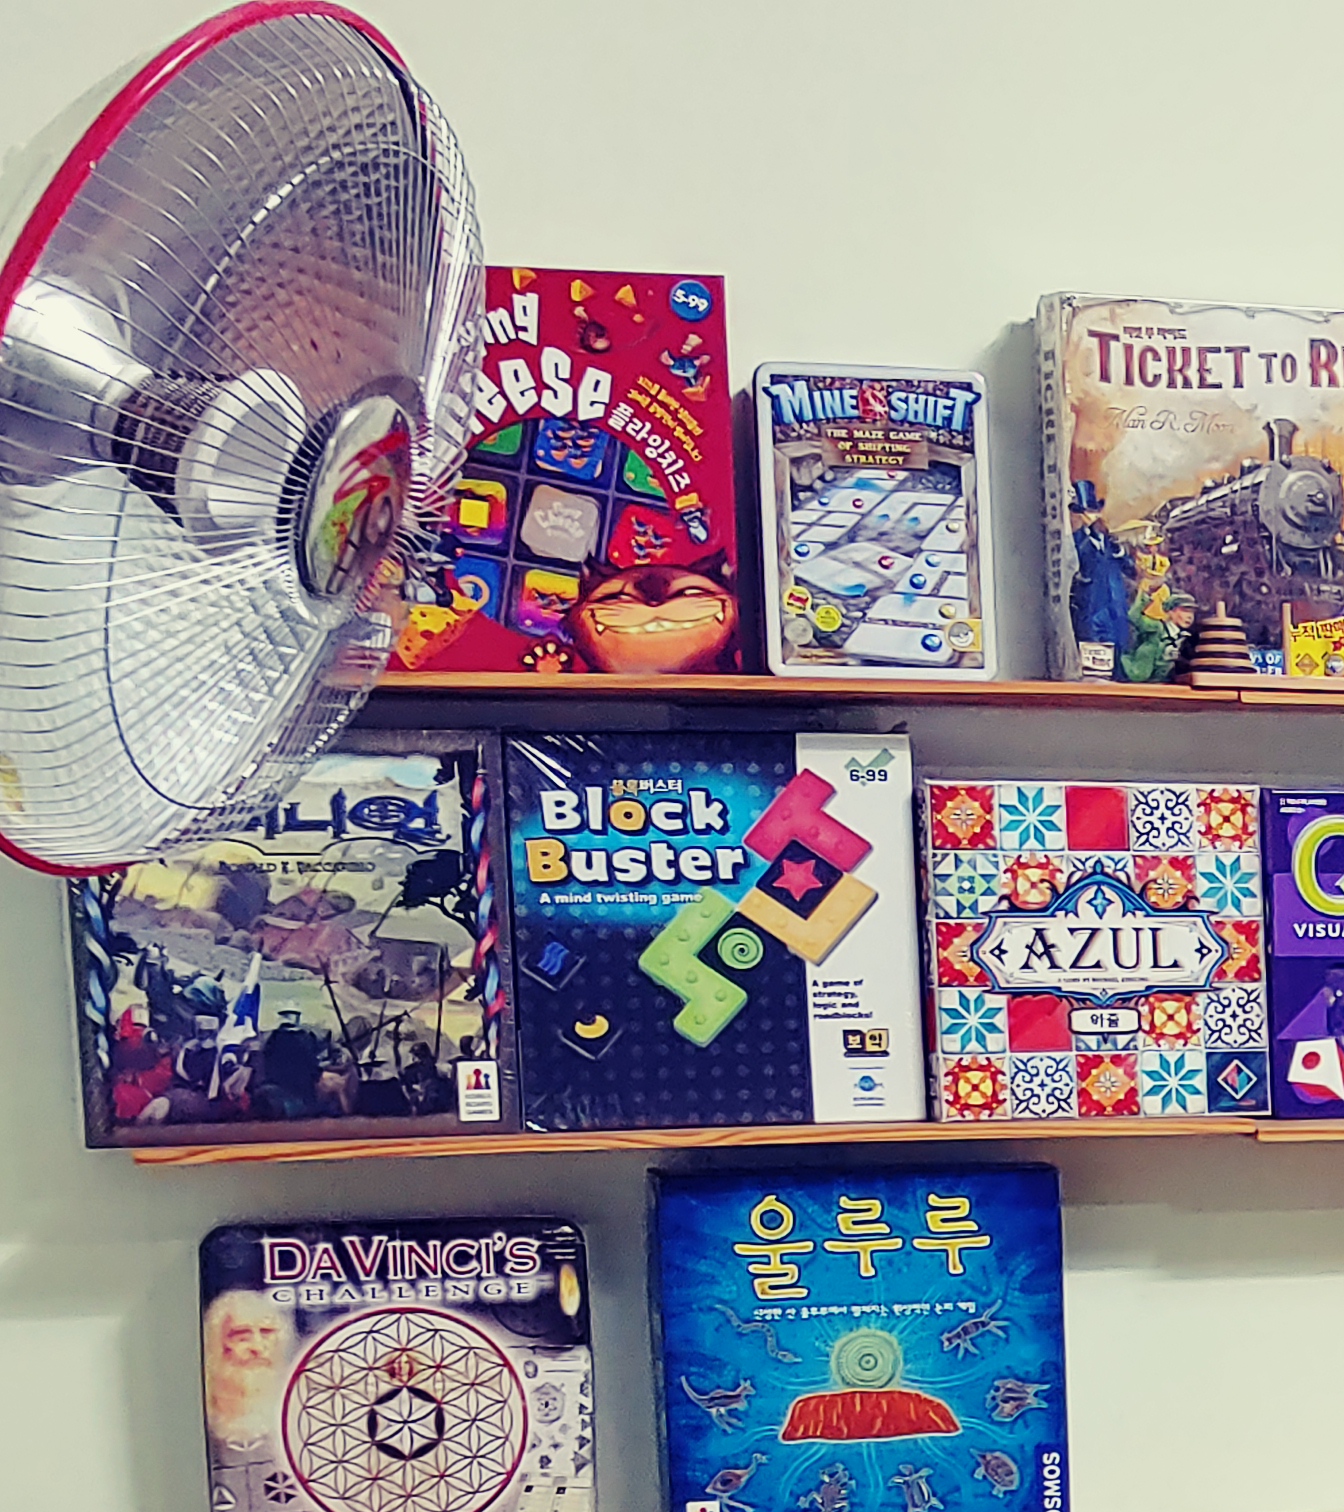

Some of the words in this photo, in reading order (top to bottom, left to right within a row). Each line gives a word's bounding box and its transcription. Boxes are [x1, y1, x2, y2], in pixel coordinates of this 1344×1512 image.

[671, 288, 709, 313] 5-99
[1087, 328, 1250, 390] TICKET
[1259, 352, 1297, 385] TO
[763, 380, 860, 424] MINE
[888, 387, 983, 432] SHIFT
[826, 428, 849, 440] THE
[889, 430, 922, 442] GAME
[844, 454, 905, 466] STRATEGY
[848, 767, 889, 783] 6-99
[539, 785, 727, 832] Block
[525, 837, 745, 883] Buster
[539, 893, 551, 904] A
[553, 892, 592, 904] mind
[596, 892, 658, 906] twisting
[661, 894, 703, 906] game
[1018, 926, 1184, 971] AZUL
[732, 1193, 992, 1301] 울루루
[271, 1279, 535, 1304] CHALLENGE
